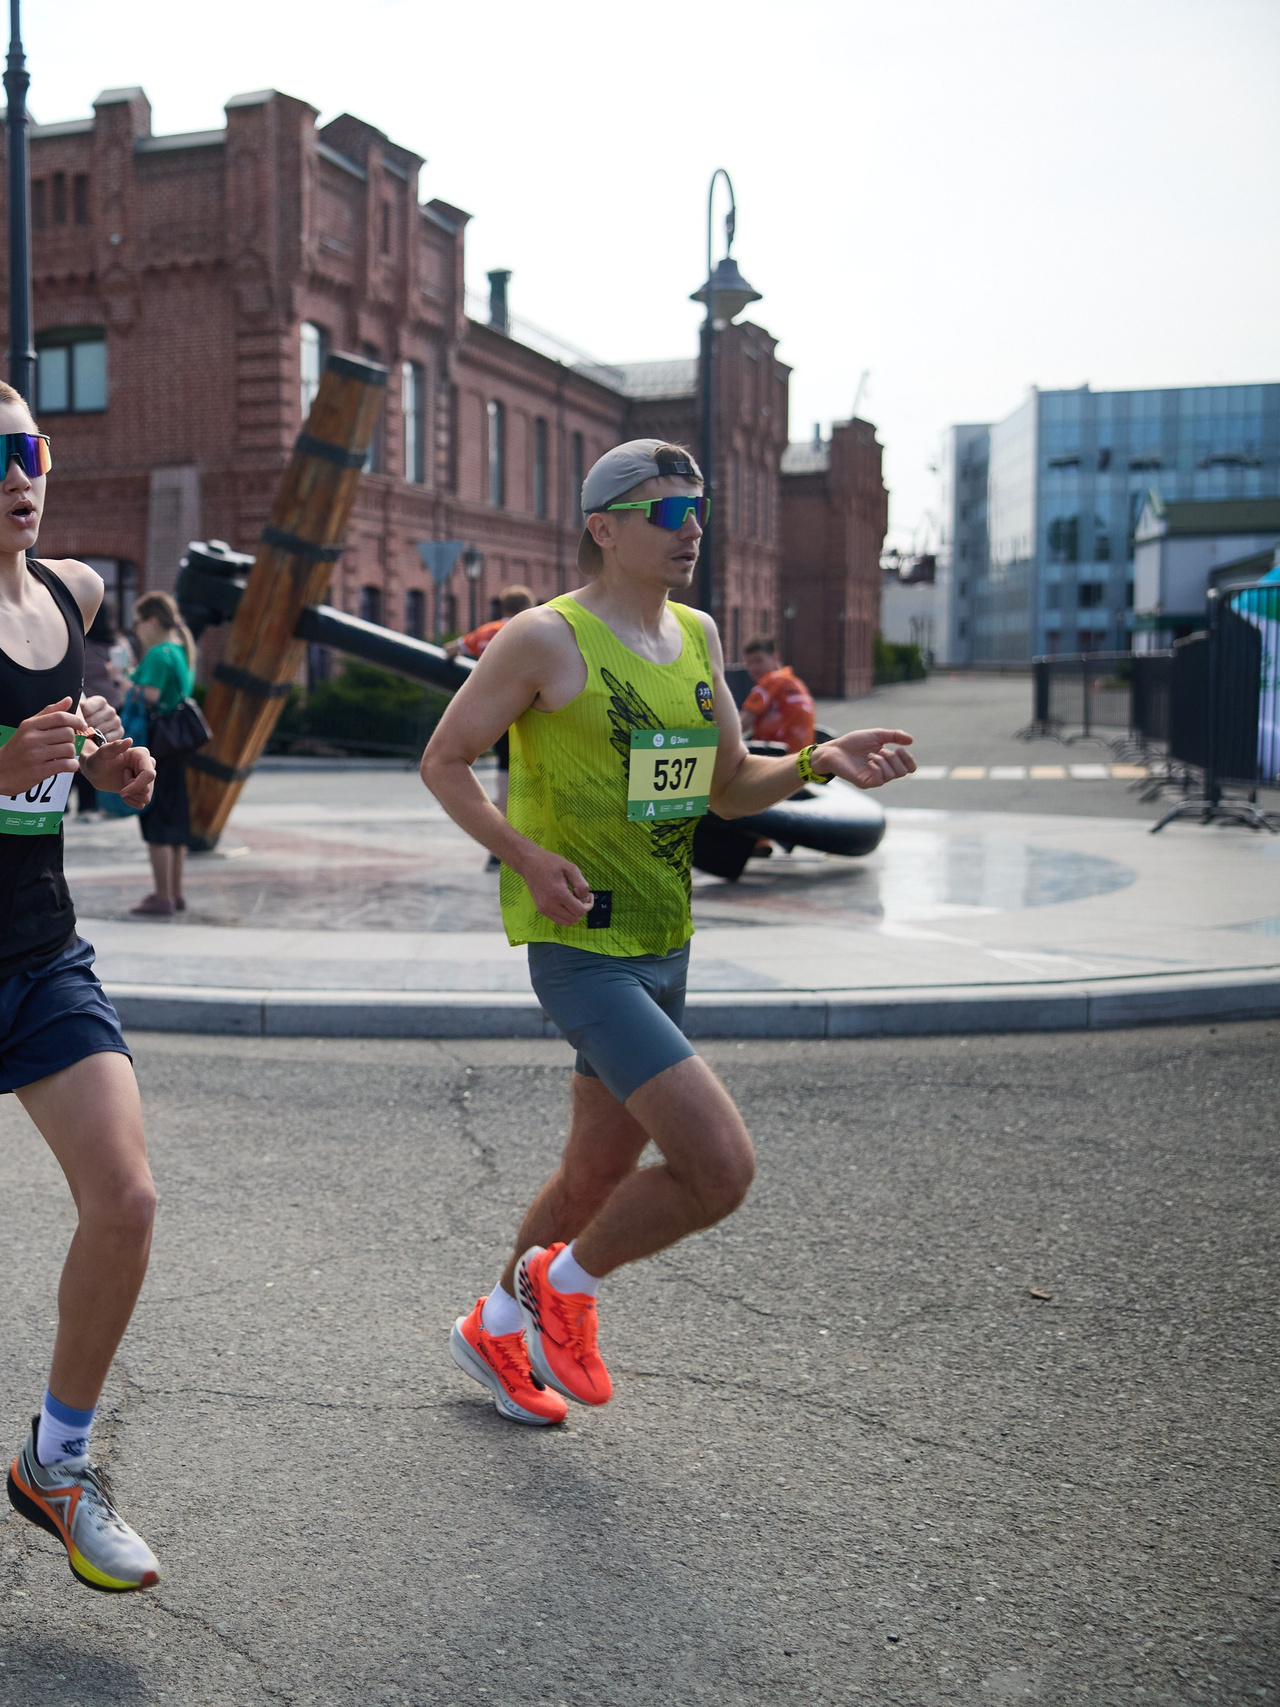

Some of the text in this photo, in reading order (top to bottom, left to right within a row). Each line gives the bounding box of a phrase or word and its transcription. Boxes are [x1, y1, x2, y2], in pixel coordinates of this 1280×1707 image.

[10, 773, 57, 803] 02
[653, 757, 697, 791] 537
[645, 802, 656, 816] A
